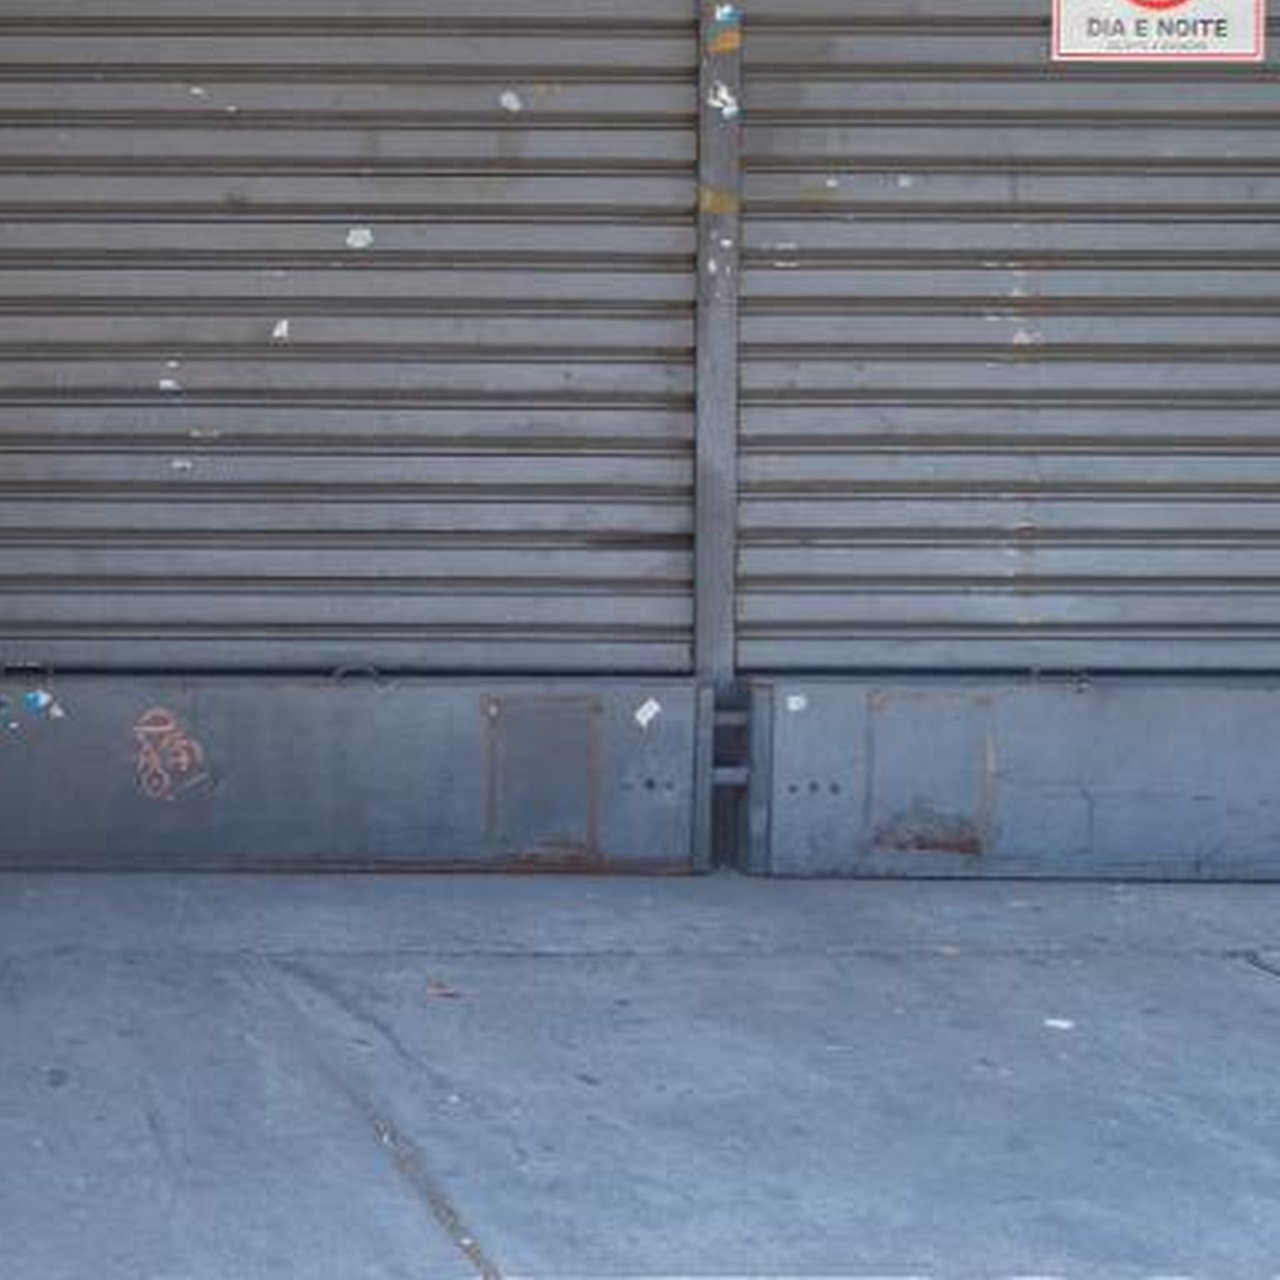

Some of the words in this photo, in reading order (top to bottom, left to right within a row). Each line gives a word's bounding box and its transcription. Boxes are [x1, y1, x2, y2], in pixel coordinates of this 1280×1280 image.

[1087, 17, 1125, 37] DIA
[1135, 17, 1148, 37] E
[1155, 17, 1228, 37] NOITE
